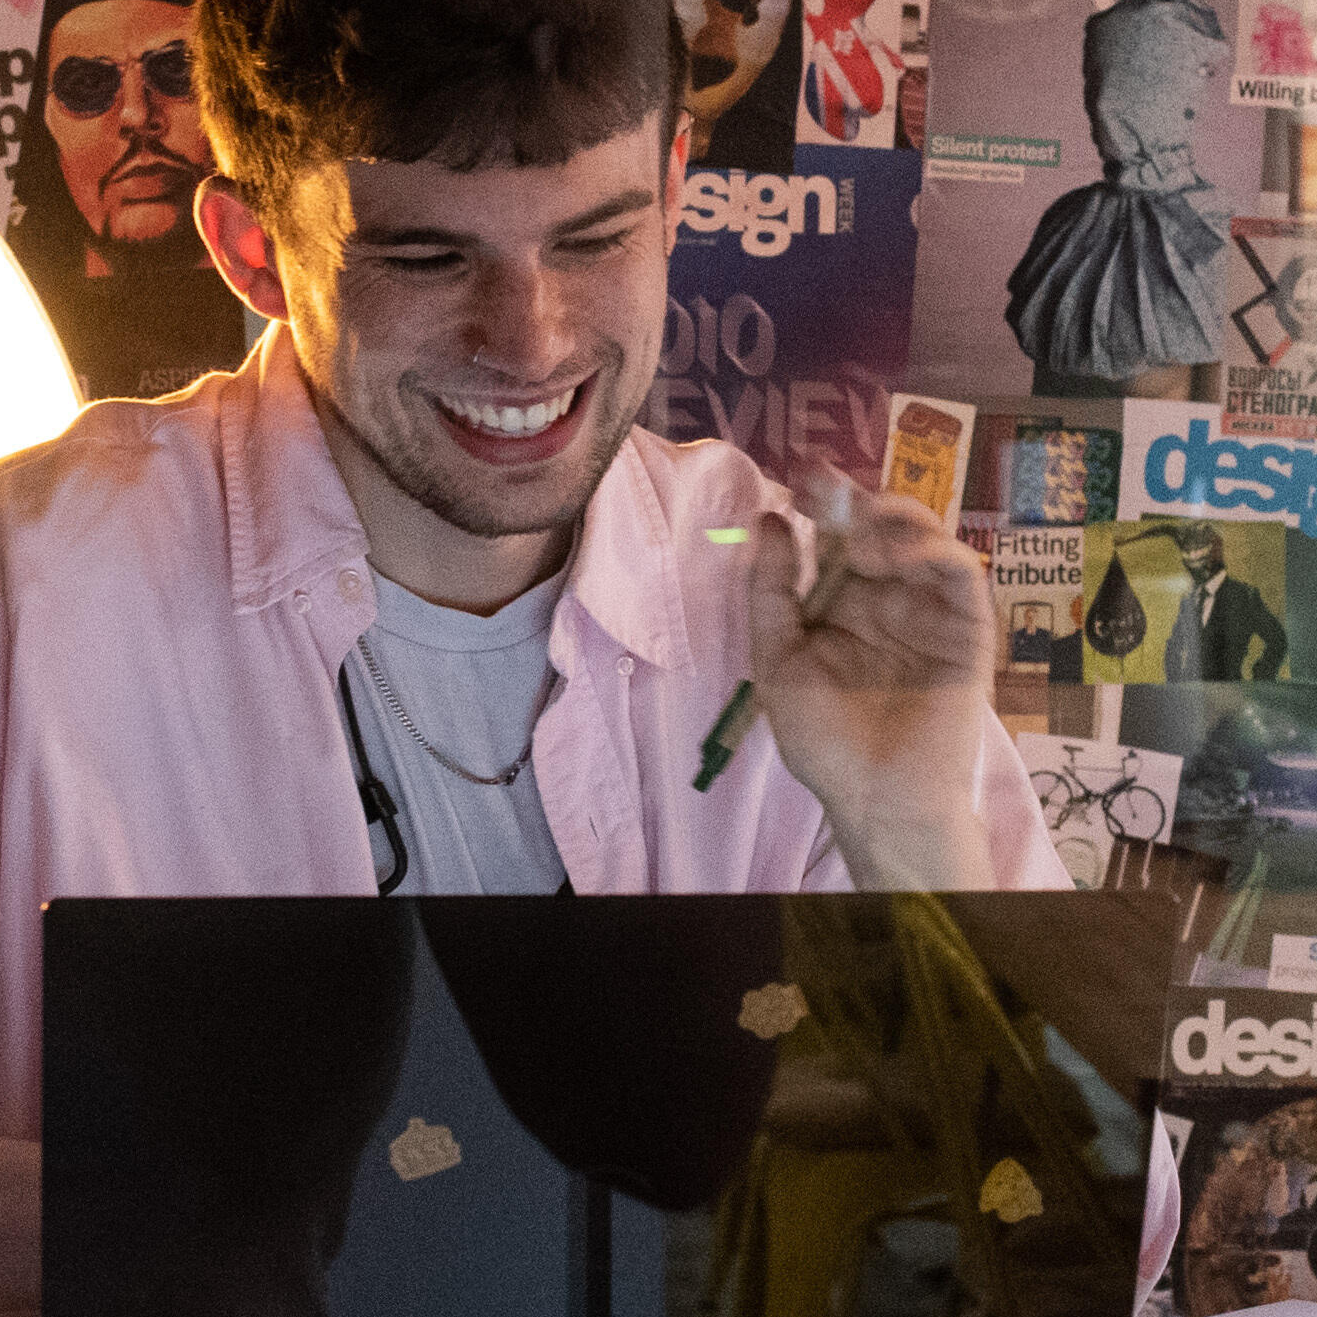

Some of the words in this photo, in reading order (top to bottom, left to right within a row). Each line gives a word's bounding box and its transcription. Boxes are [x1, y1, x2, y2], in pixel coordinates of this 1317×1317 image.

[1237, 80, 1305, 105] Willing
[930, 134, 983, 159] Silent
[987, 139, 1059, 166] protest
[840, 178, 856, 233] WEEK
[996, 531, 1080, 563] Fitting
[996, 562, 1083, 586] tribute
